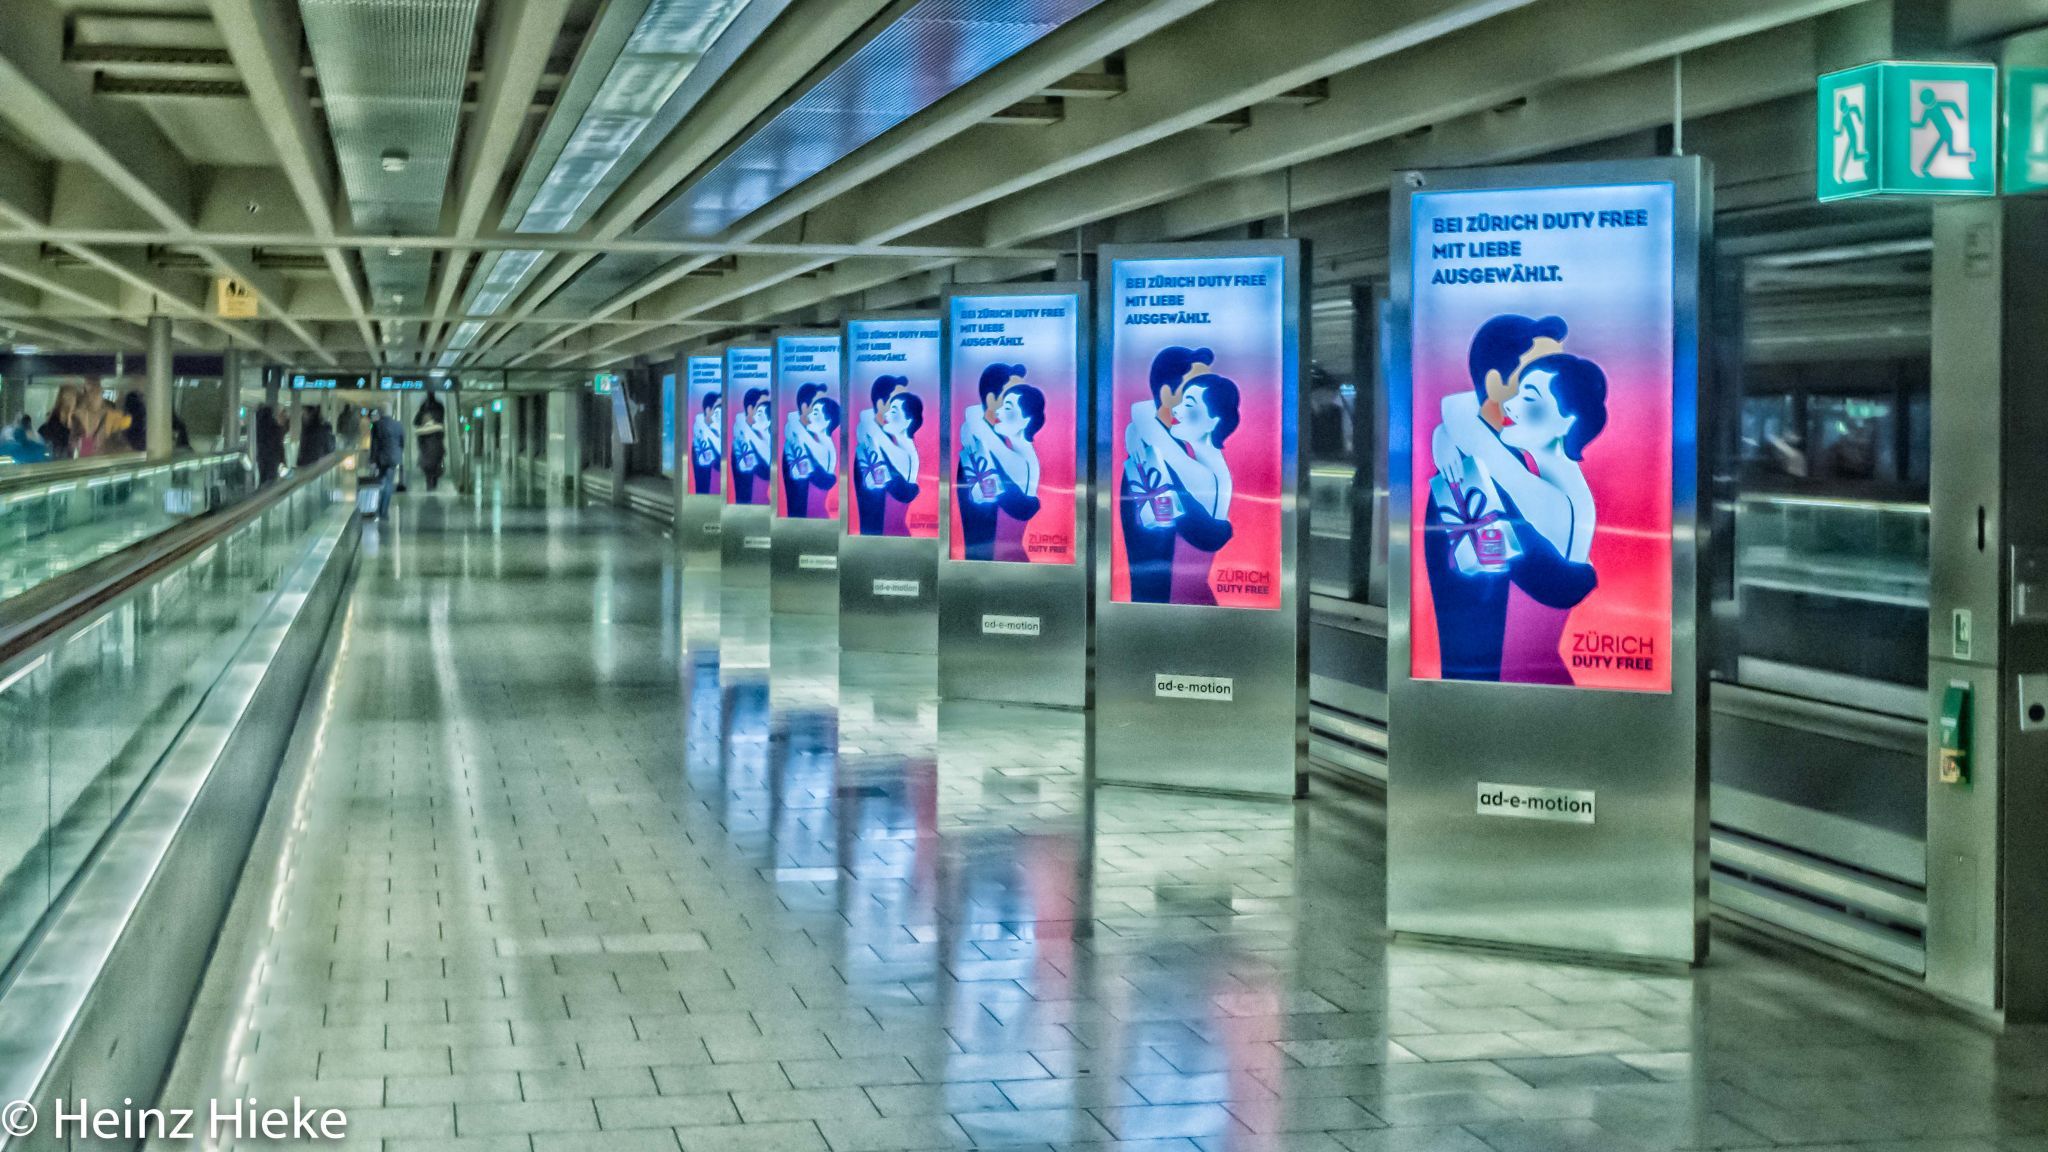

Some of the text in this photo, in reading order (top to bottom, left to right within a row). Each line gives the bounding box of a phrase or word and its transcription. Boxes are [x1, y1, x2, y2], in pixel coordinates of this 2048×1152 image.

[1432, 209, 1648, 233] BEI ZÜRICH DUTY FREE
[1432, 241, 1521, 259] MIT LIEBE
[1125, 274, 1266, 289] BEI ZÜRICH DUTY FREE
[1431, 264, 1563, 285] AUSGEWÄHLT.
[1125, 294, 1184, 307] MIT LIEBE
[960, 308, 976, 319] BEI
[1014, 308, 1040, 318] DUTY
[1041, 308, 1065, 318] FREE
[1125, 310, 1211, 325] AUSGEWÄHLT.
[978, 323, 1004, 333] LIEBE
[1216, 584, 1269, 595] DUTY FREE
[984, 620, 1039, 631] ad-e-motion
[1572, 630, 1654, 655] ZÜRICH
[1572, 655, 1653, 670] DUTY FREE
[1157, 680, 1231, 695] ad-e-motion
[1480, 791, 1592, 813] ad-e-motion
